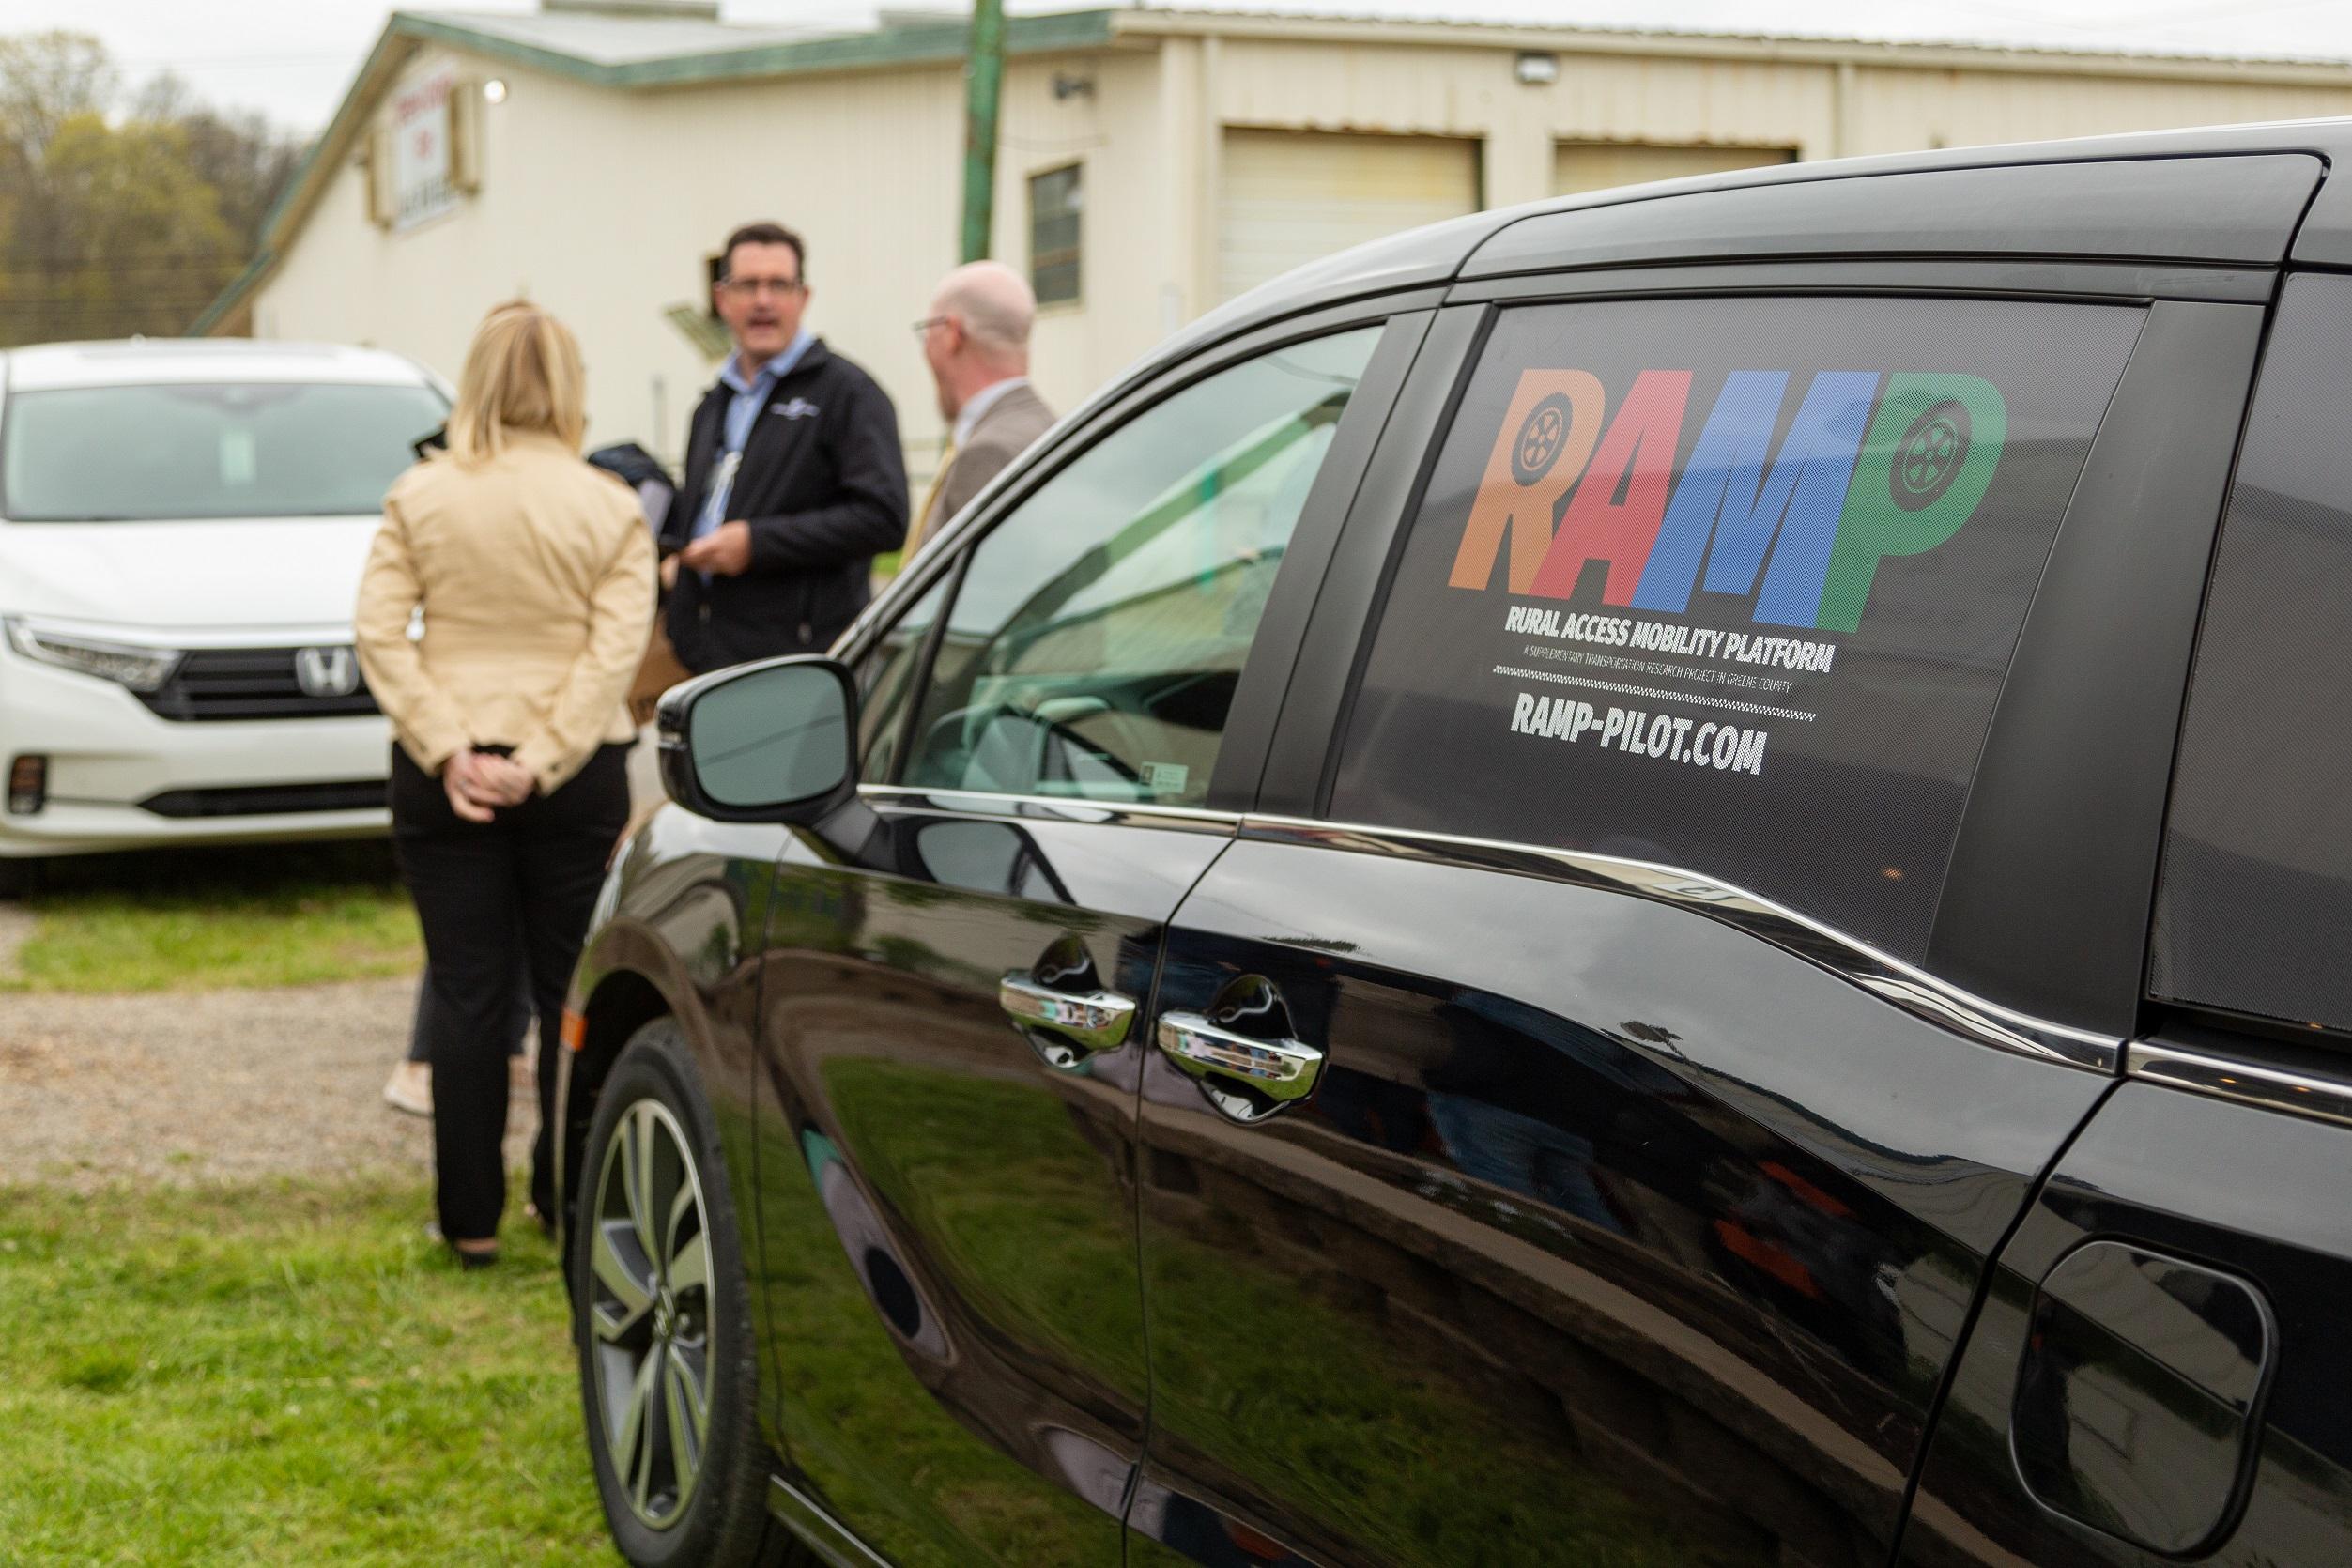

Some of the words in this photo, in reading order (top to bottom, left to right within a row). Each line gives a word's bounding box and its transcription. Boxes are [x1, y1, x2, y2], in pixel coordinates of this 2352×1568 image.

[1448, 369, 2008, 634] RAMP
[1505, 606, 1560, 638] RURAL
[1560, 613, 1632, 646] ACCESS
[1629, 621, 1726, 657] MOBILITY
[1723, 632, 1836, 673] PLATFORM
[1523, 644, 1530, 655] A
[1529, 645, 1584, 665] SUPPLEMENTARY
[1585, 653, 1645, 672] TRANSPORTATION
[1645, 661, 1683, 678] RESEARCH
[1683, 668, 1717, 682] PROJECT
[1716, 671, 1727, 684] IN
[1727, 673, 1757, 689] GREENE
[1758, 677, 1792, 693] COUNTY
[1511, 692, 1768, 776] RAMP-PILOT.COM
